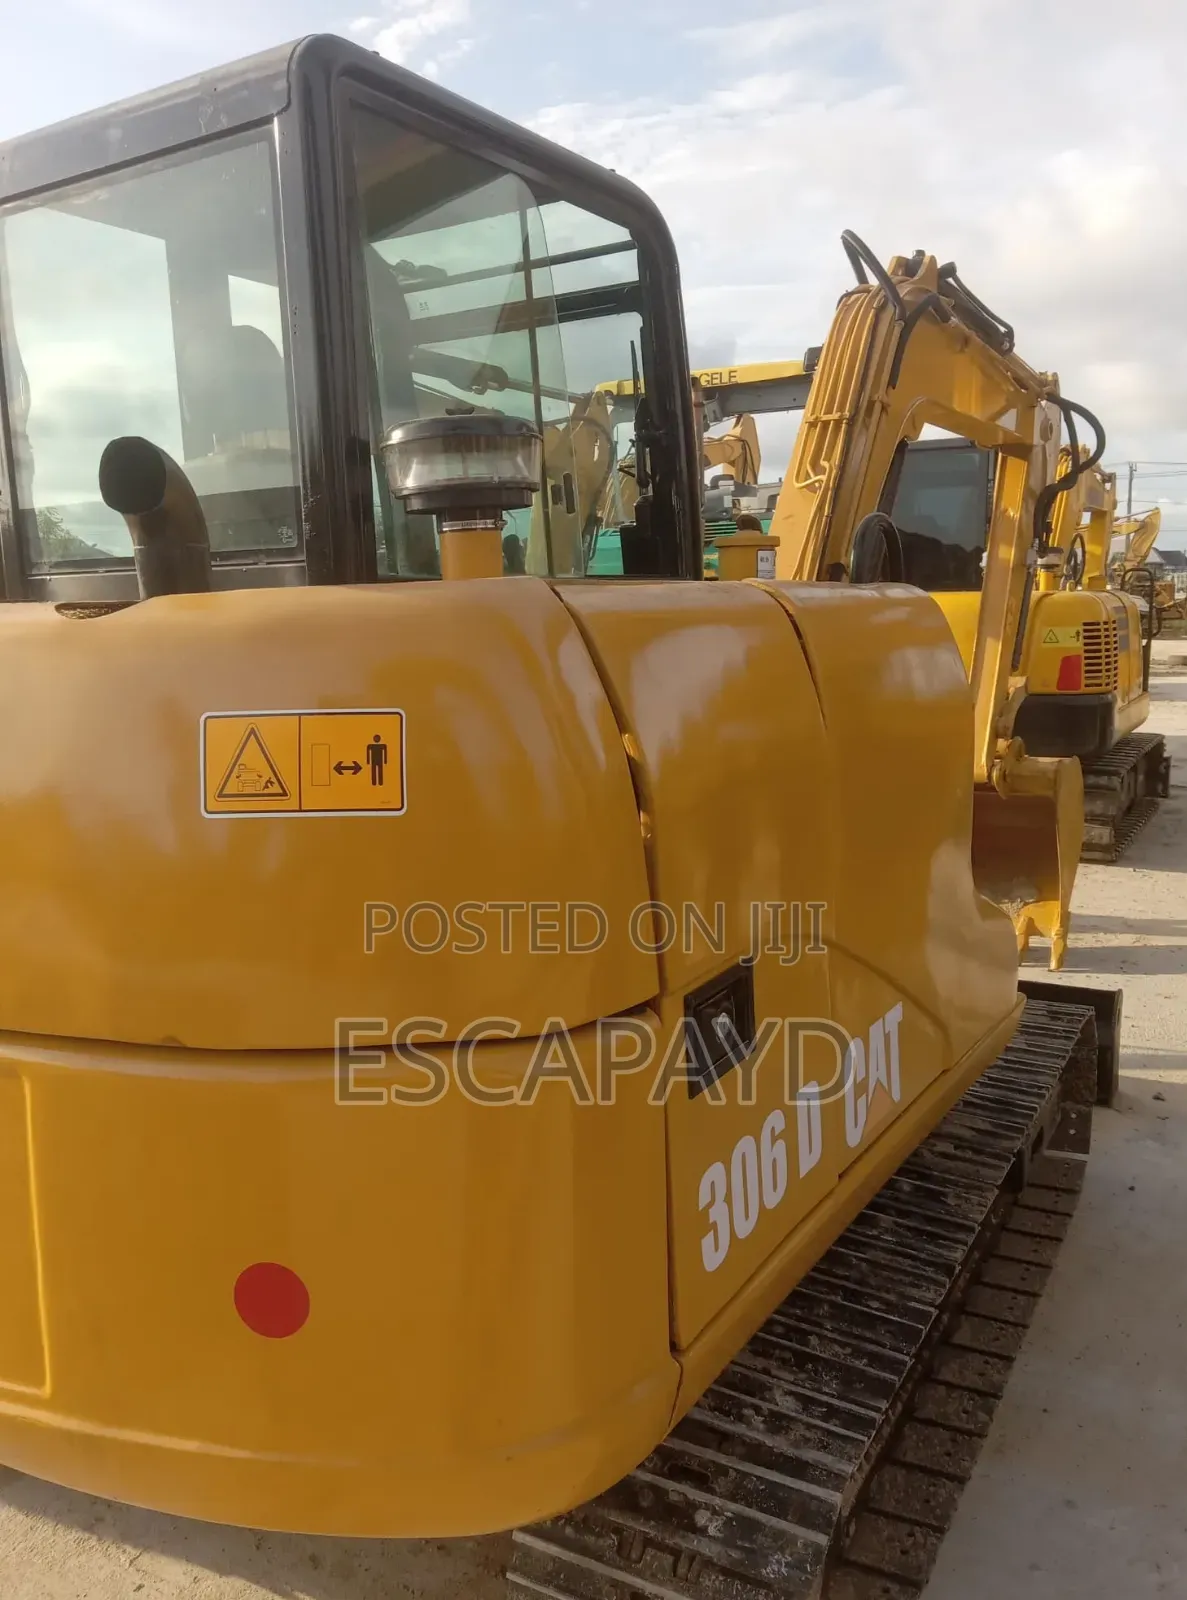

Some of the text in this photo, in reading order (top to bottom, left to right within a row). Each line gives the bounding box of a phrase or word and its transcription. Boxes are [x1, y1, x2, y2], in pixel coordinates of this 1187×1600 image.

[698, 1001, 903, 1273] 306 D CAT
